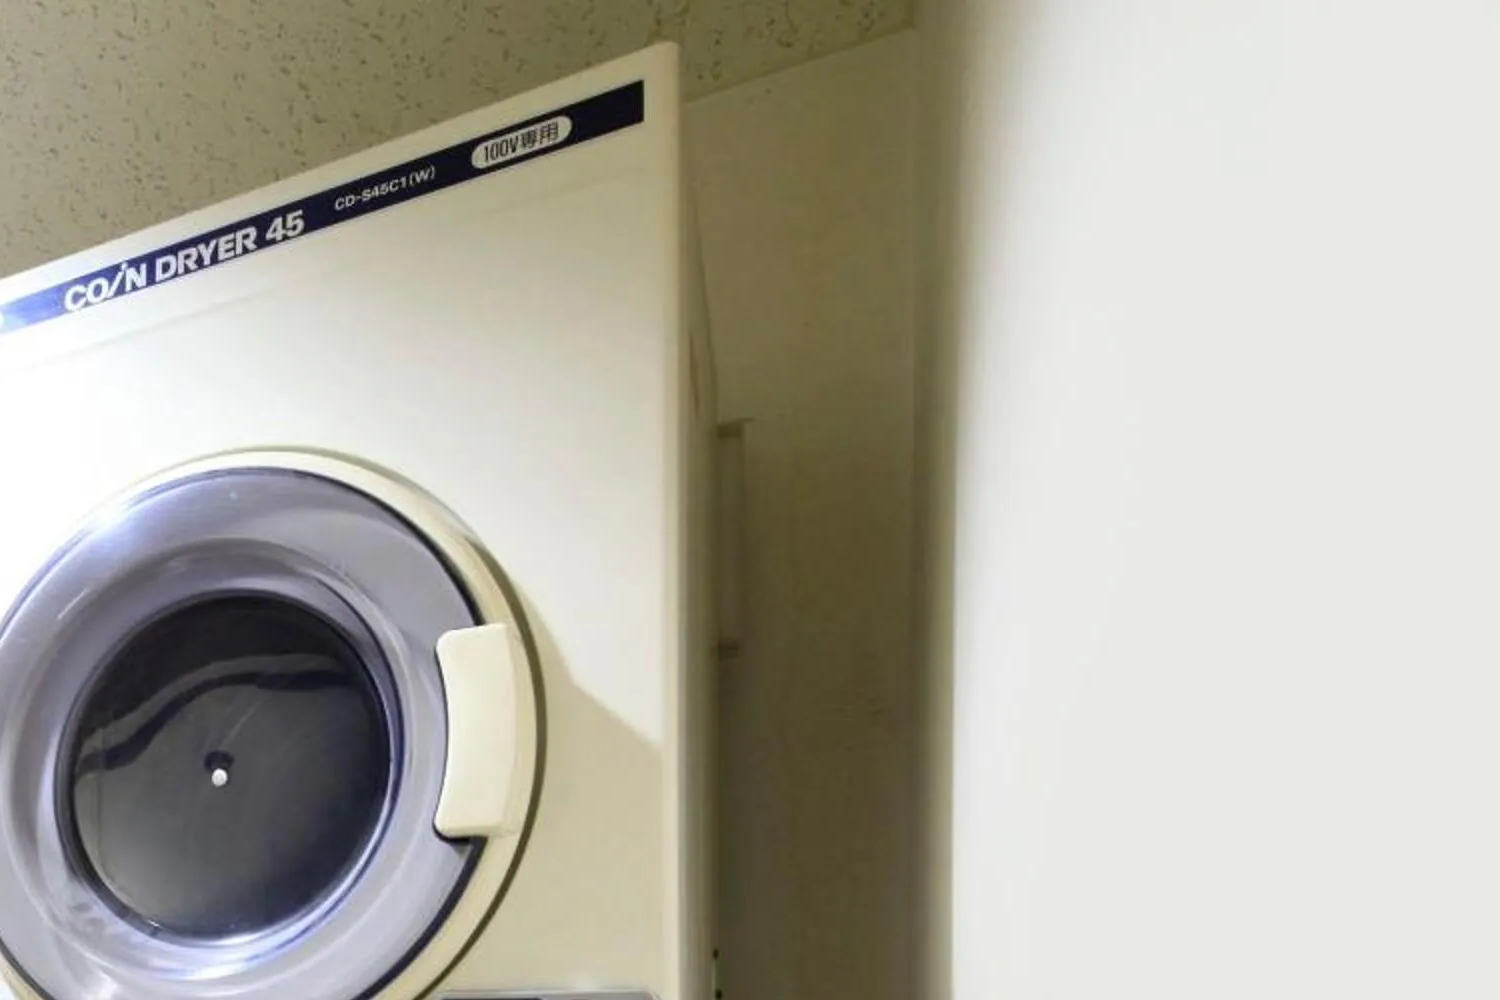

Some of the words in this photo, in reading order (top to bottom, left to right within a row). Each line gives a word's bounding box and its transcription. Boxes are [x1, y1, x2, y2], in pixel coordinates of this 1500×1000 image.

[483, 121, 560, 164] 100V専用
[64, 260, 147, 313] COIN
[155, 226, 258, 283] DRYER
[265, 209, 306, 242] 45
